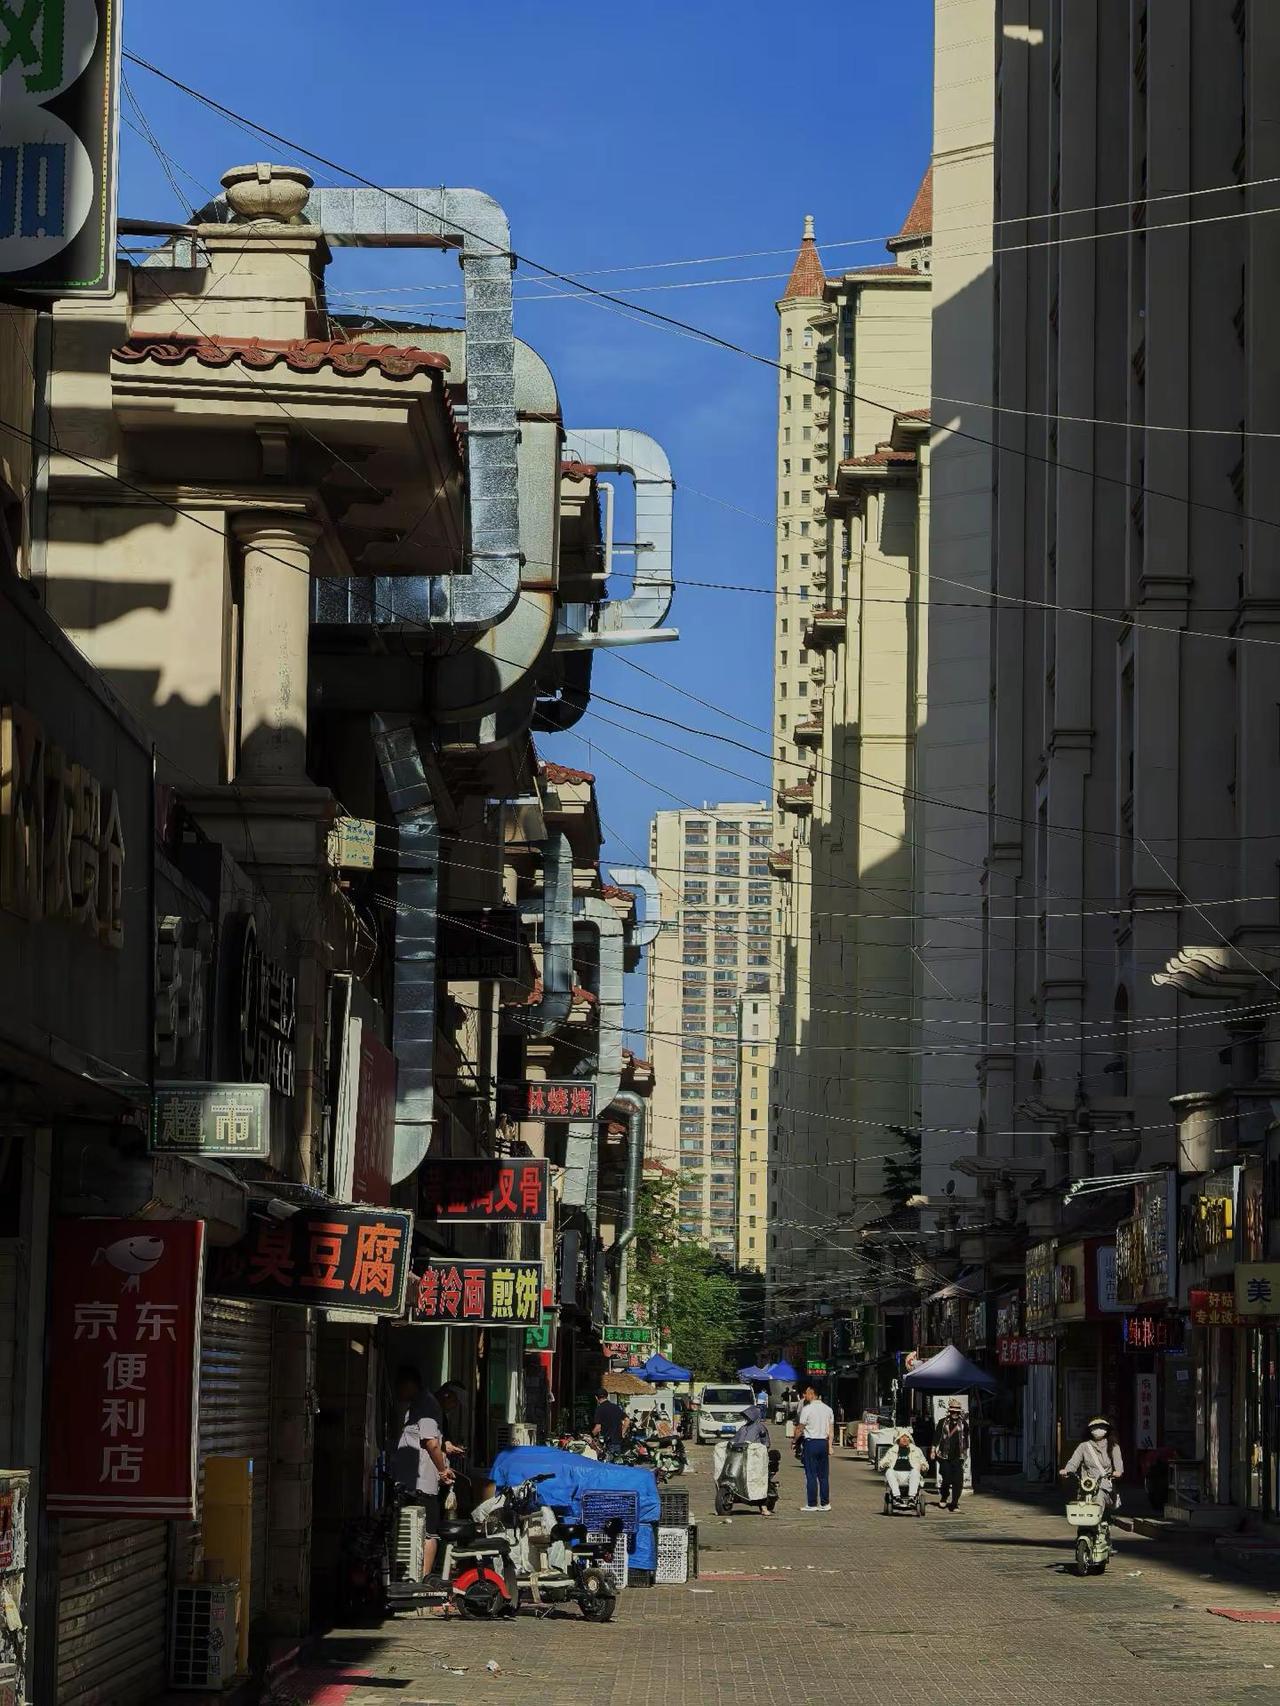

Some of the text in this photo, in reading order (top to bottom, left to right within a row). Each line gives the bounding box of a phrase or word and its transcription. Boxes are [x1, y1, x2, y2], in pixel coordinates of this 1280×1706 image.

[163, 1097, 254, 1145] 超市
[492, 1268, 538, 1320] 煎饼
[1248, 1278, 1272, 1303] 美
[73, 1301, 179, 1342] 京东
[99, 1352, 147, 1484] 便利店
